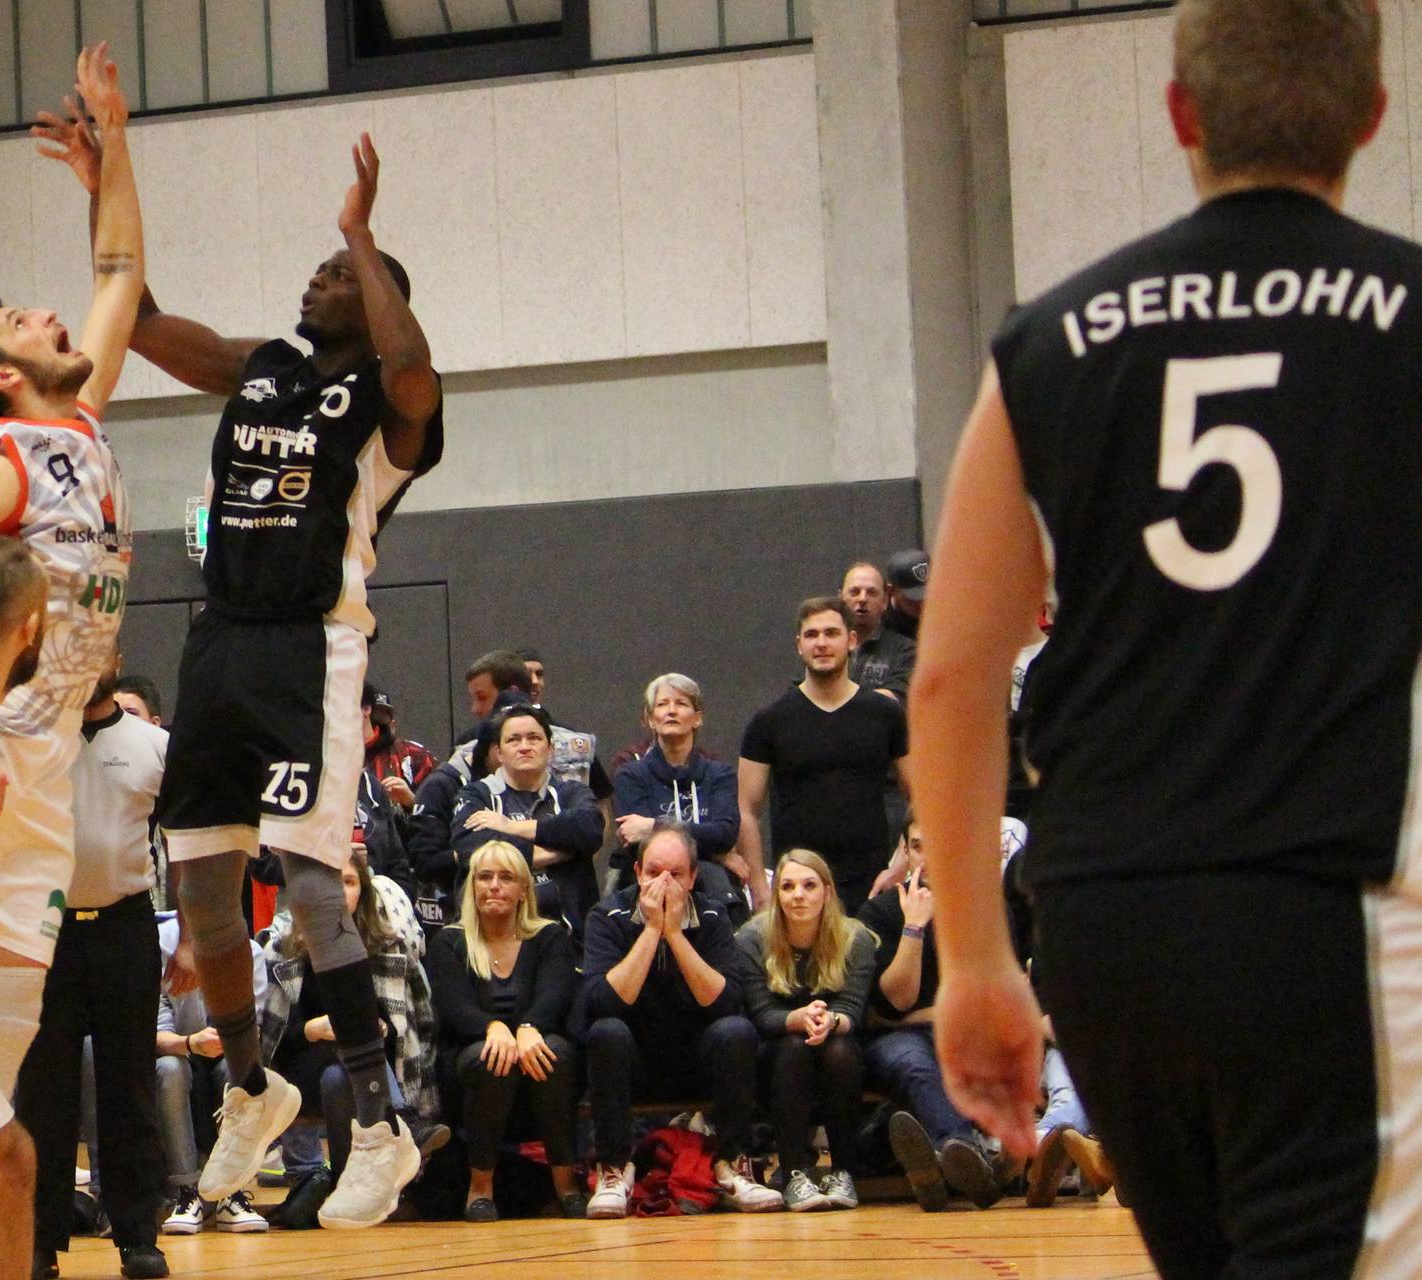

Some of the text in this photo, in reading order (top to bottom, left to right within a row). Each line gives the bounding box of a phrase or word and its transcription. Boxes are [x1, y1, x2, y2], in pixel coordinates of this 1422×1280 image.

[1062, 267, 1408, 358] ISERLOHN
[47, 453, 80, 497] 9
[1142, 352, 1284, 592] 5
[260, 760, 311, 811] 15
